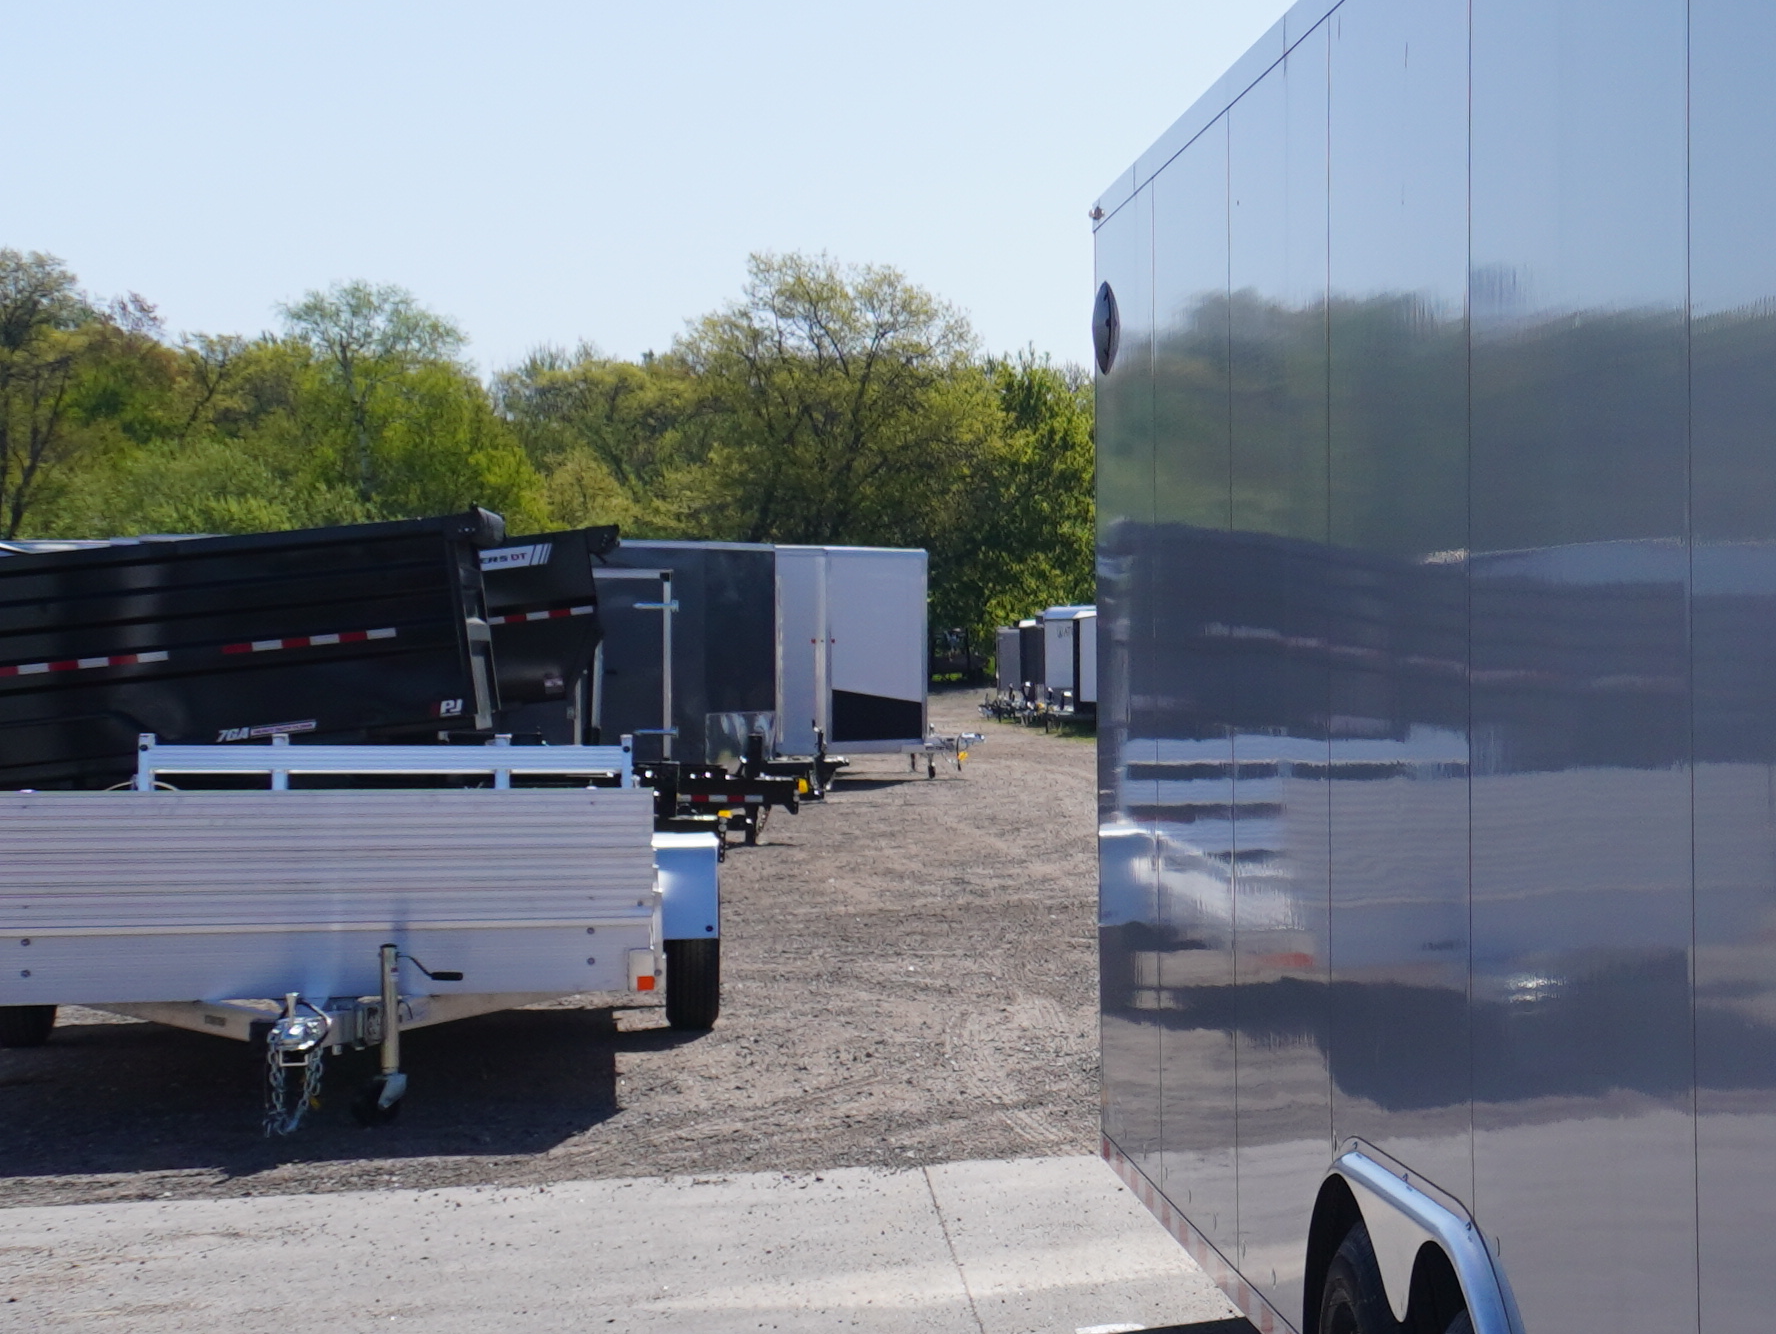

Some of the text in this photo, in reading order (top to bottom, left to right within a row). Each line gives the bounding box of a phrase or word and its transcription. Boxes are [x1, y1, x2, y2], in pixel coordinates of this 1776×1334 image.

[510, 552, 527, 562] DT
[440, 699, 462, 715] PJ
[216, 727, 249, 743] 7GA
